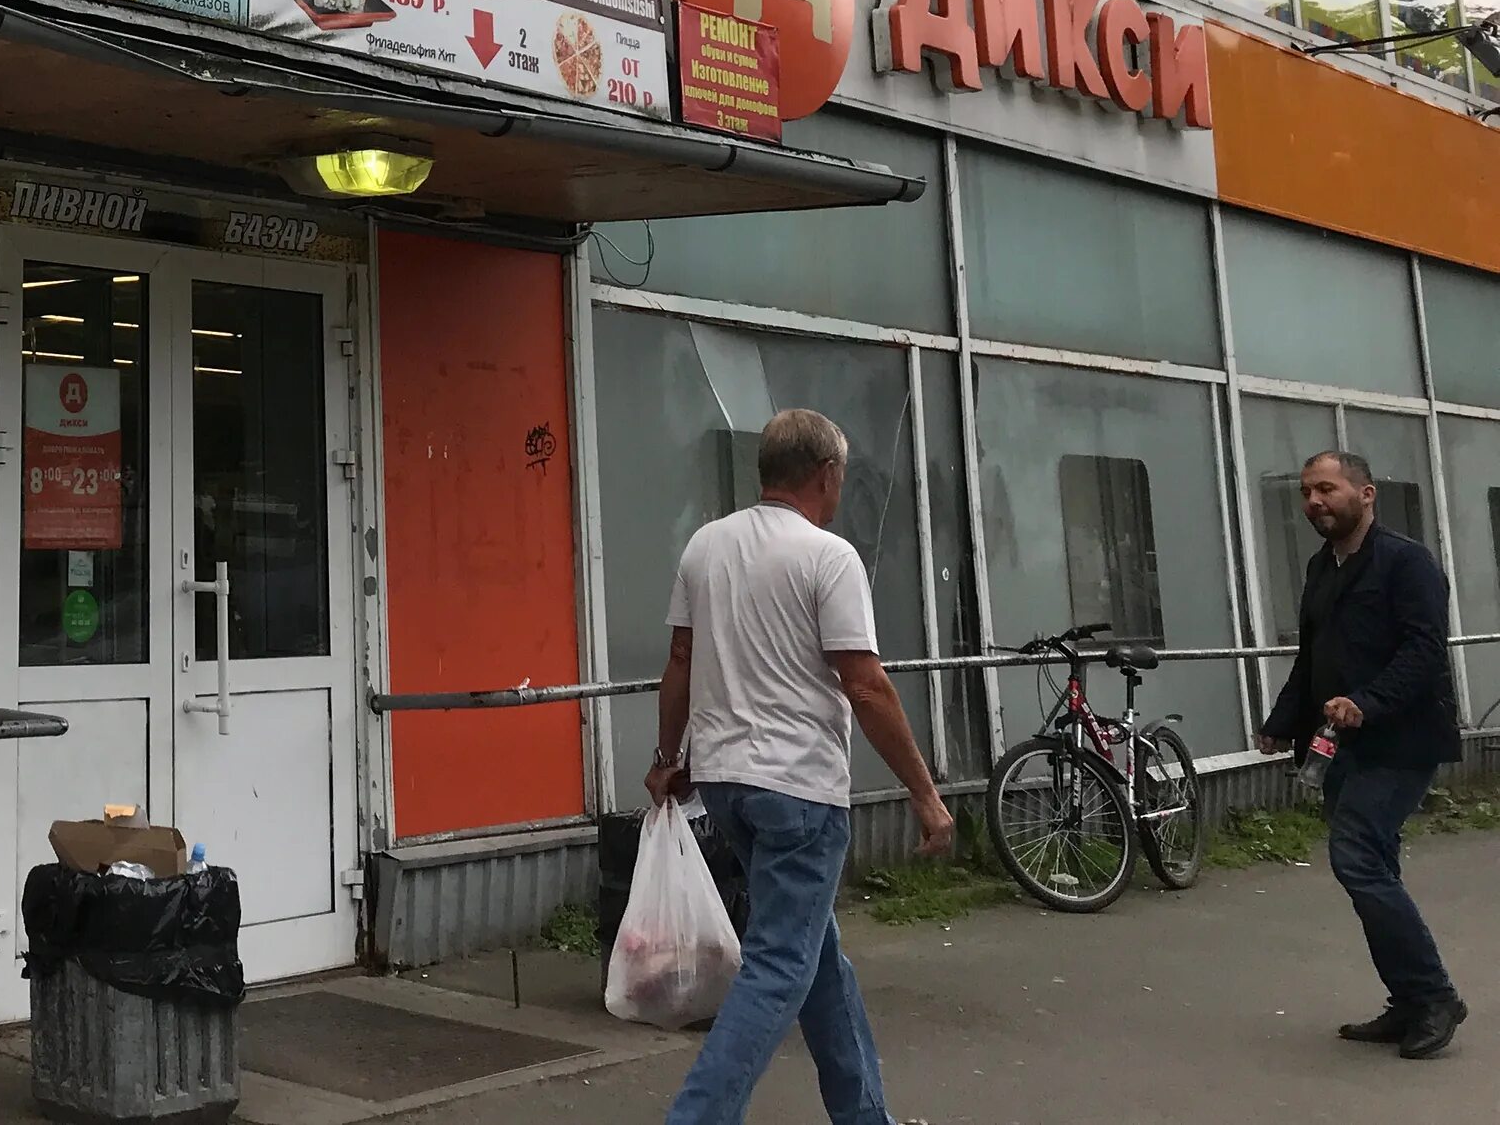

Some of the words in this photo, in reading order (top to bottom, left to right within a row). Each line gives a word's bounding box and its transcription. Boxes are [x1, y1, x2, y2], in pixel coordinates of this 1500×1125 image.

[519, 28, 527, 49] 2
[700, 12, 758, 51] РЕМОНТ
[365, 32, 436, 59] Филадельфия
[437, 48, 457, 64] Хит
[701, 43, 726, 62] обуви
[508, 51, 539, 74] этаж
[691, 58, 769, 96] Изготовление
[607, 78, 637, 106] 210
[716, 110, 724, 127] 3
[724, 115, 749, 132] этаж
[10, 180, 149, 233] ПИВНОЙ
[225, 210, 319, 252] БАЗАР
